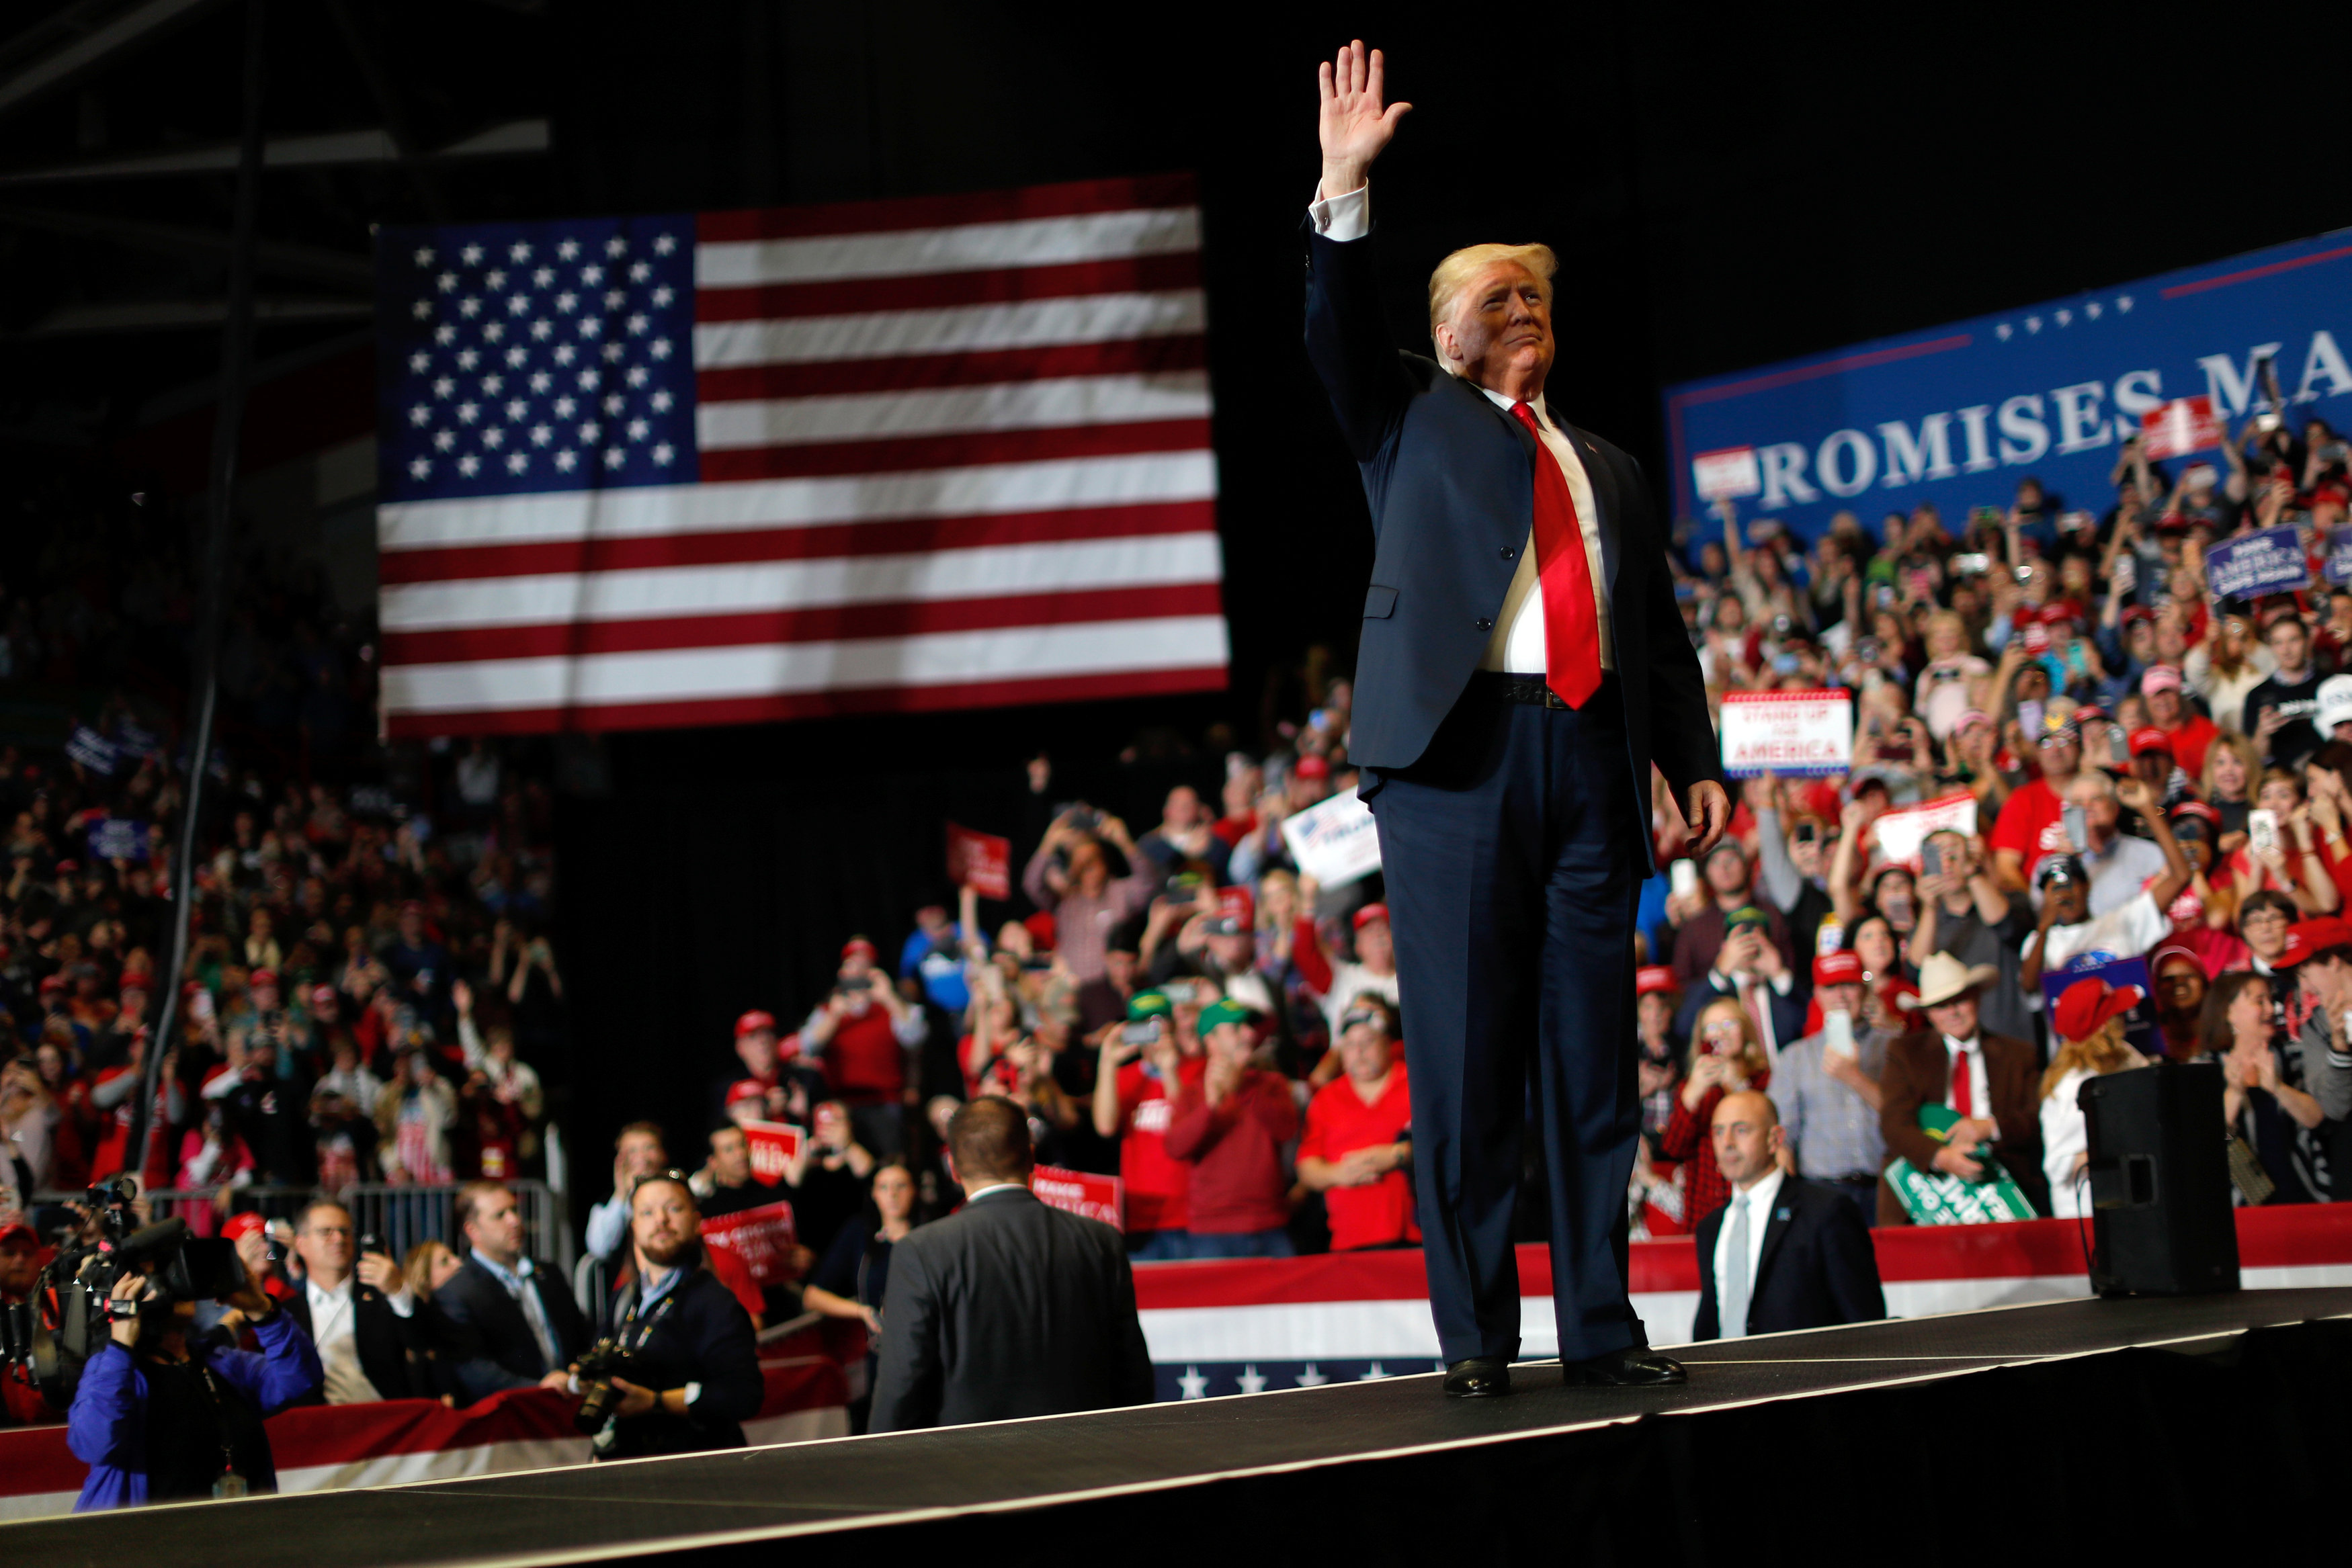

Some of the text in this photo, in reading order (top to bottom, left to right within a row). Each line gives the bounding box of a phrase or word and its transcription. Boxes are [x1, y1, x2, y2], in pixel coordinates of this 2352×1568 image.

[1707, 368, 2162, 521] ROMISES
[1742, 703, 1799, 723] STAND
[1734, 738, 1839, 760] AMERICA
